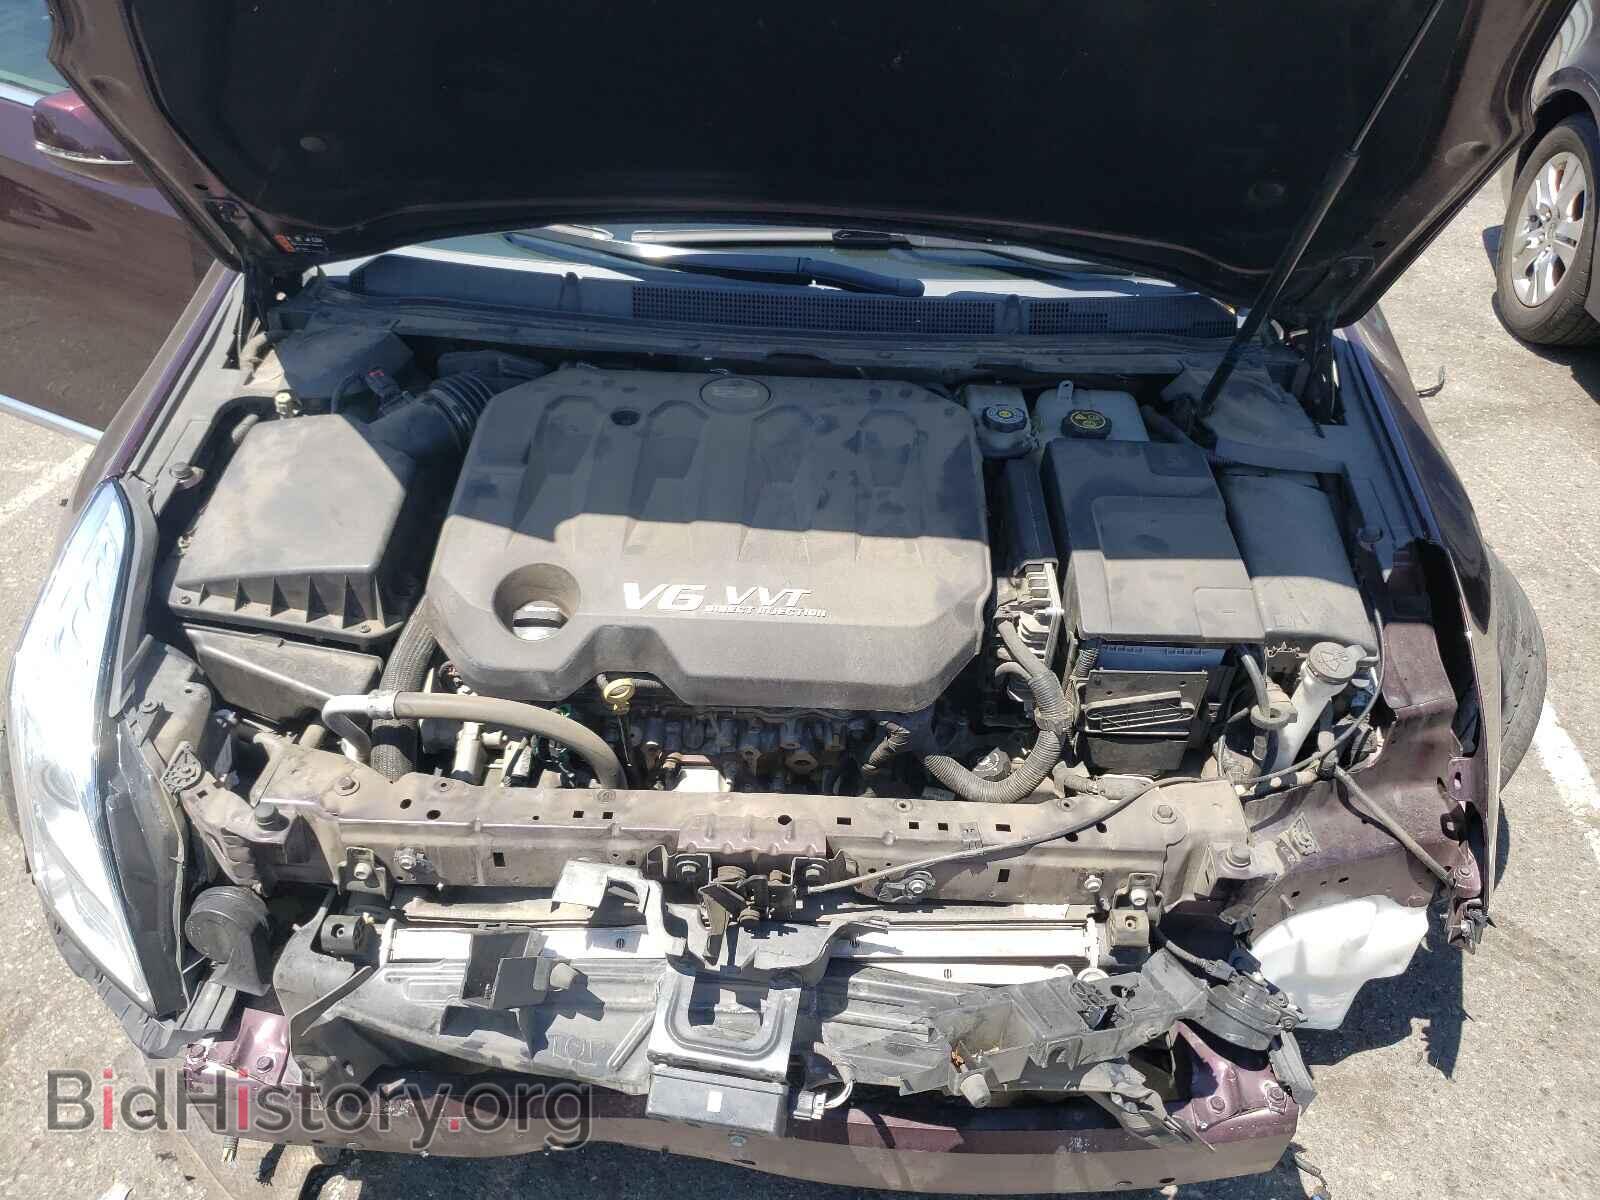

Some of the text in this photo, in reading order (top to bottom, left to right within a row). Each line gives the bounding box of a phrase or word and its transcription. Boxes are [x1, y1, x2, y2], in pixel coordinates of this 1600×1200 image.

[623, 582, 812, 611] V6 VVT
[703, 604, 828, 618] DIRECT INJECTION
